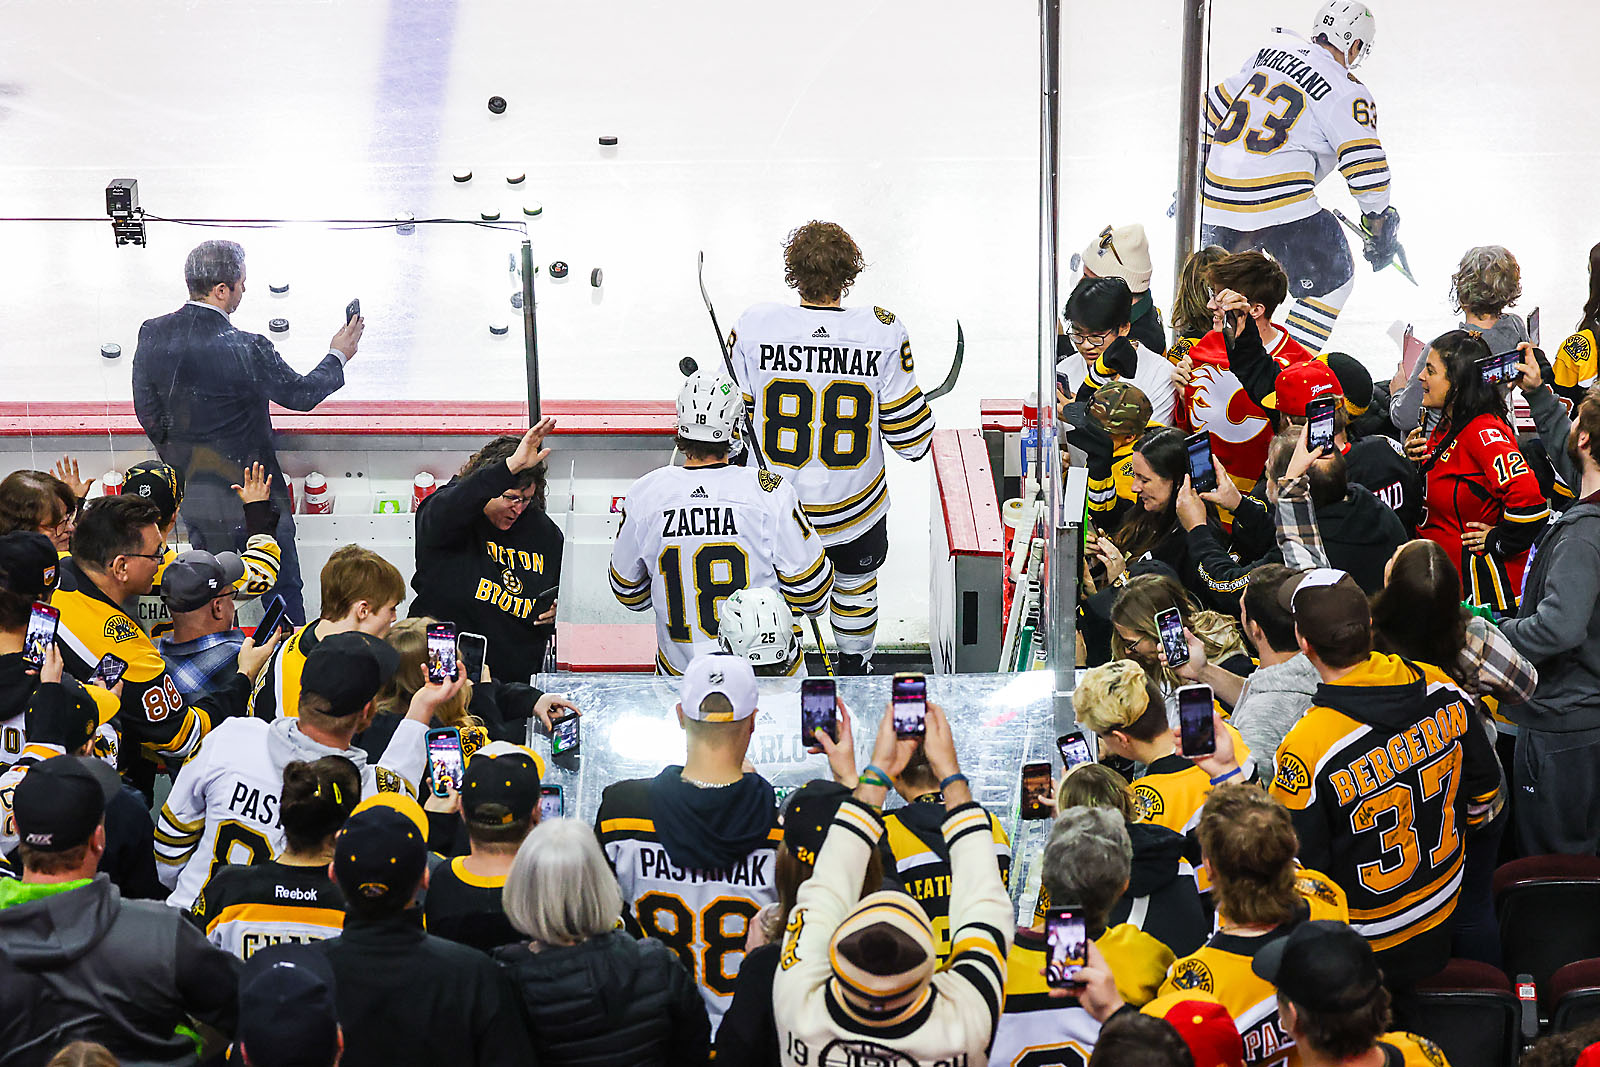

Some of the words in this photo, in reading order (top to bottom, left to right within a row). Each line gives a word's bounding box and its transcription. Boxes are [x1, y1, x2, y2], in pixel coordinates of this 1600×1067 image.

[1322, 14, 1335, 27] 63
[1252, 47, 1333, 101] MARCHAND
[1213, 71, 1307, 156] 63
[759, 344, 882, 377] PASTRNAK
[695, 413, 707, 425] 18
[762, 377, 875, 471] 88
[1492, 451, 1530, 487] 12
[1373, 481, 1404, 512] ND
[662, 507, 738, 538] ZACHA
[138, 601, 174, 620] CHA
[474, 577, 537, 619] BRUIN
[658, 541, 751, 644] 18
[761, 632, 776, 644] 25
[142, 673, 183, 722] 88
[1328, 700, 1469, 807] BERGERON
[228, 781, 285, 831] PAS
[1350, 740, 1464, 895] 37
[275, 885, 318, 901] Reebok
[634, 889, 763, 998] 88
[787, 1031, 808, 1067] 19
